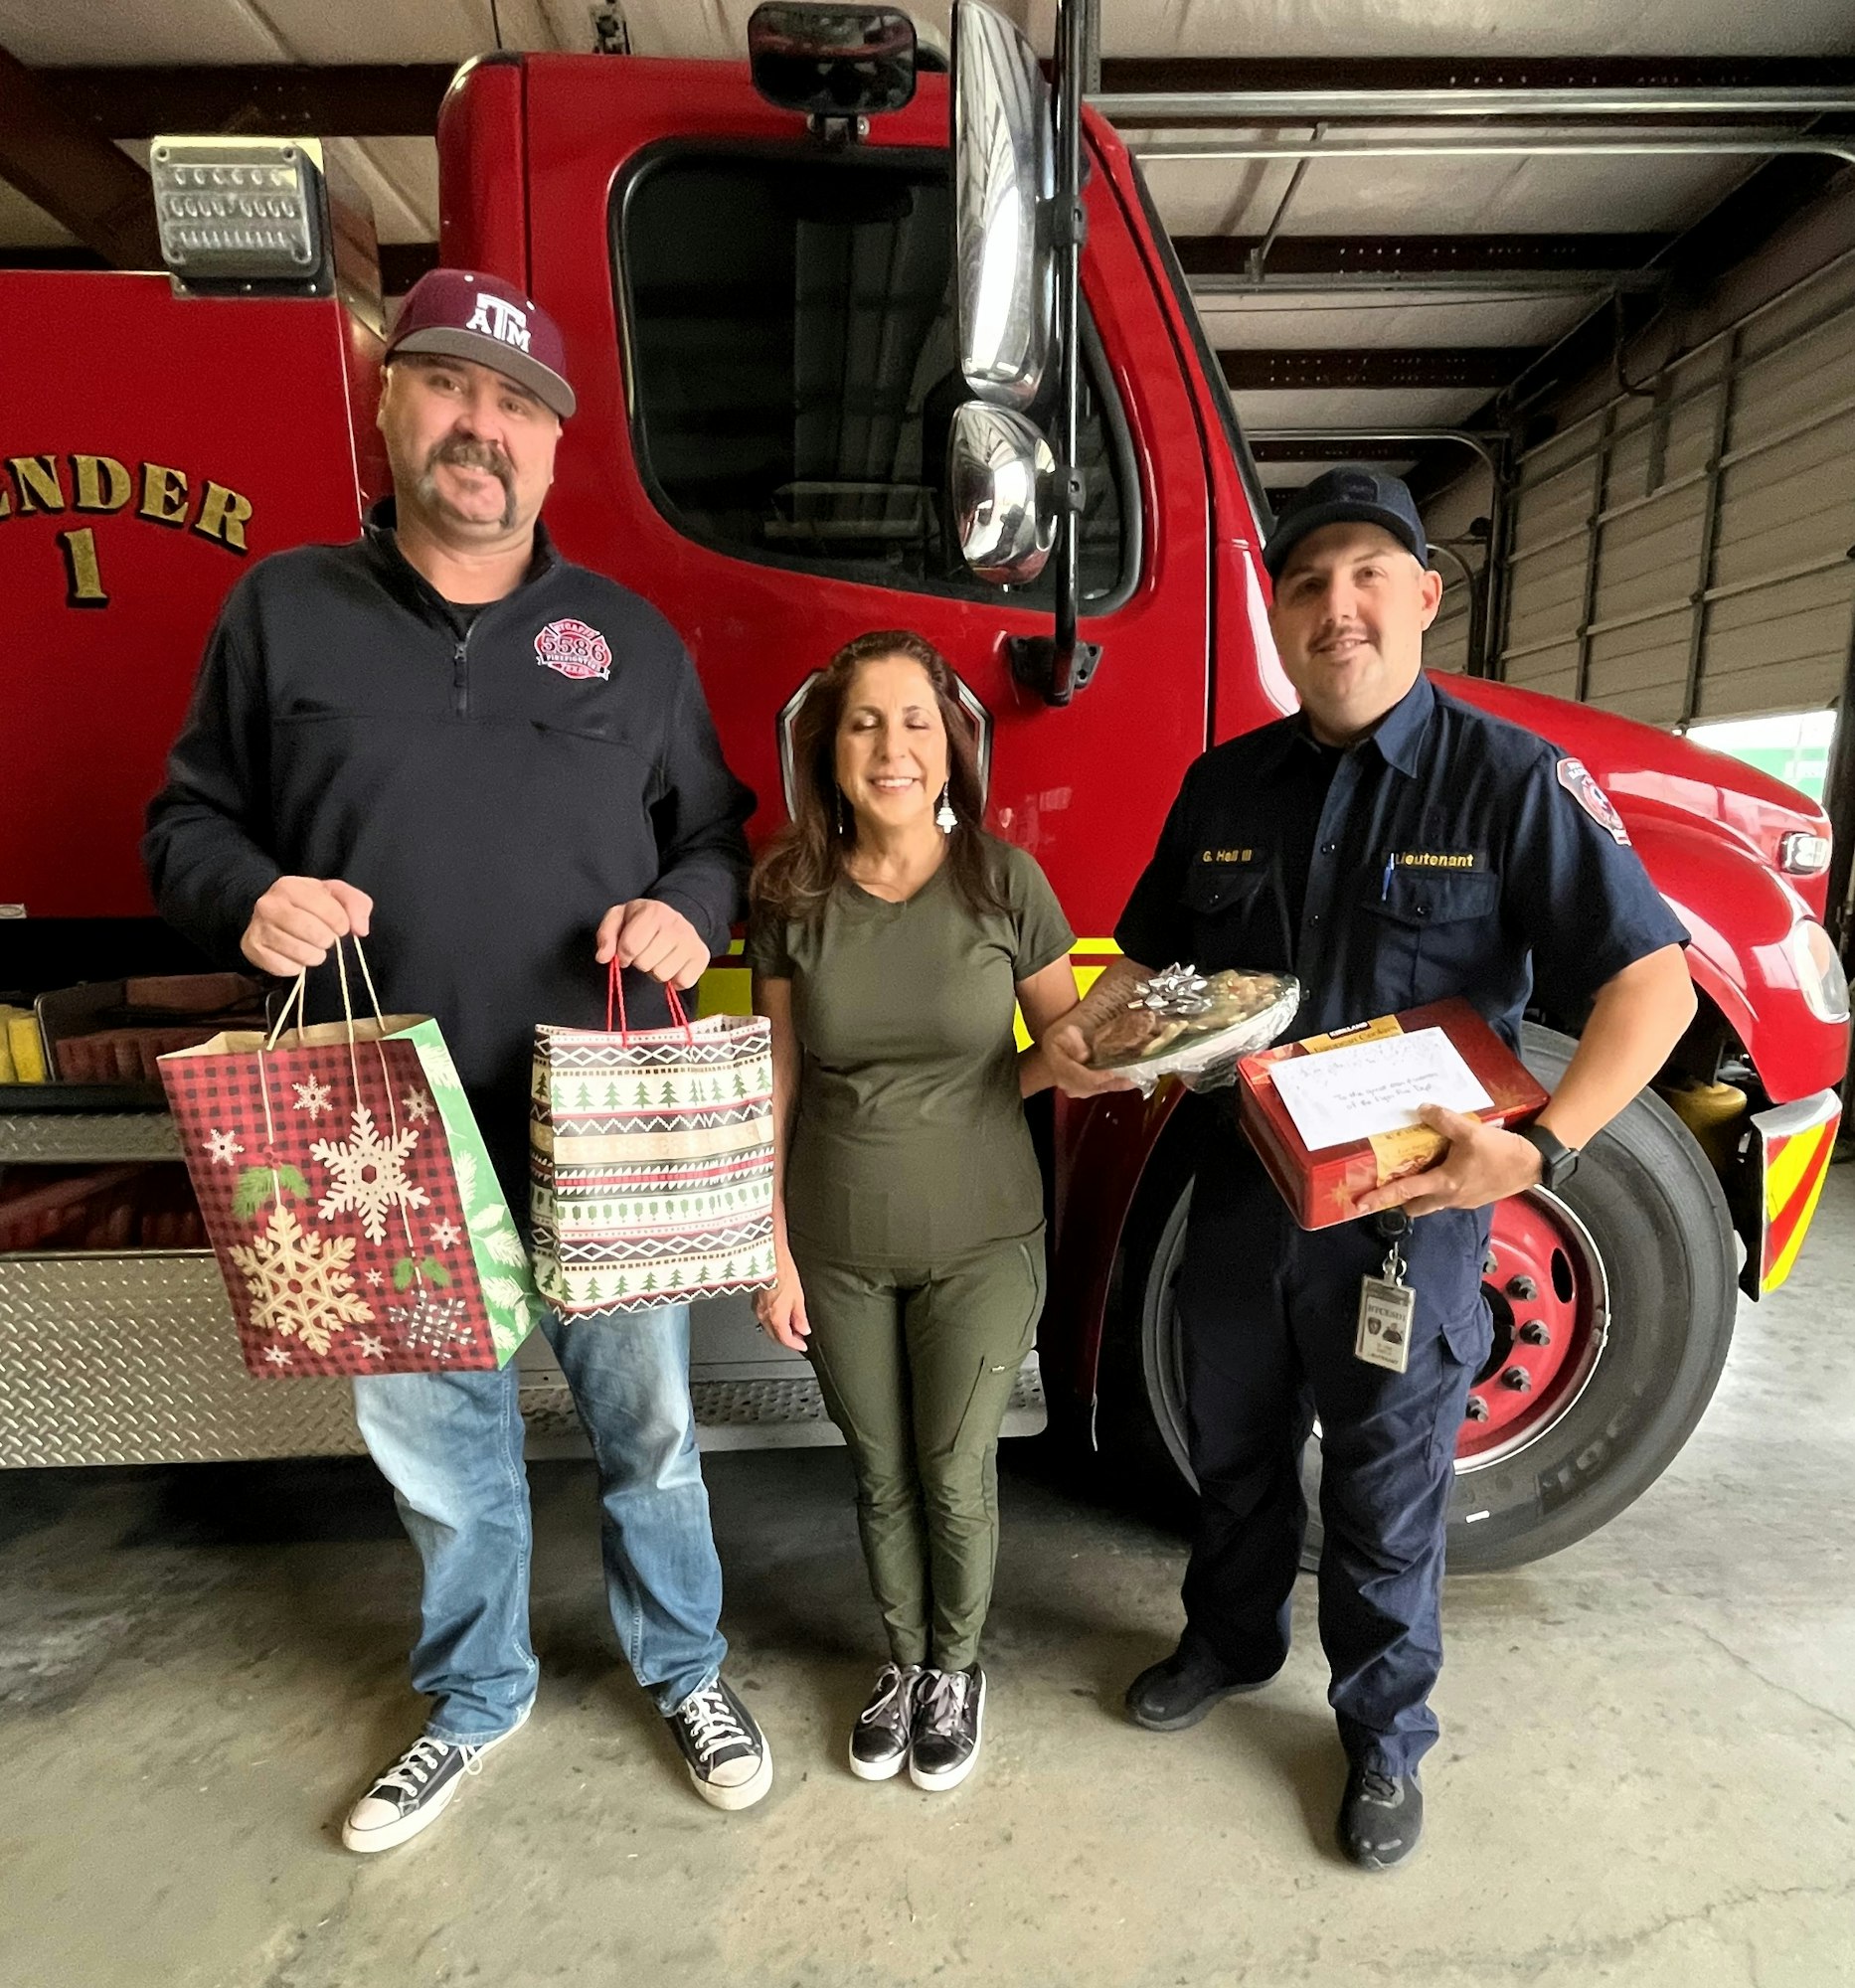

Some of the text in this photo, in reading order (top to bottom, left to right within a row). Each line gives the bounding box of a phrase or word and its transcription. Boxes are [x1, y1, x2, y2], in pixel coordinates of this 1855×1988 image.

[0, 454, 253, 553] NDER
[58, 527, 108, 609] 1
[541, 634, 606, 664] 5586
[1395, 852, 1474, 868] Lieutenant
